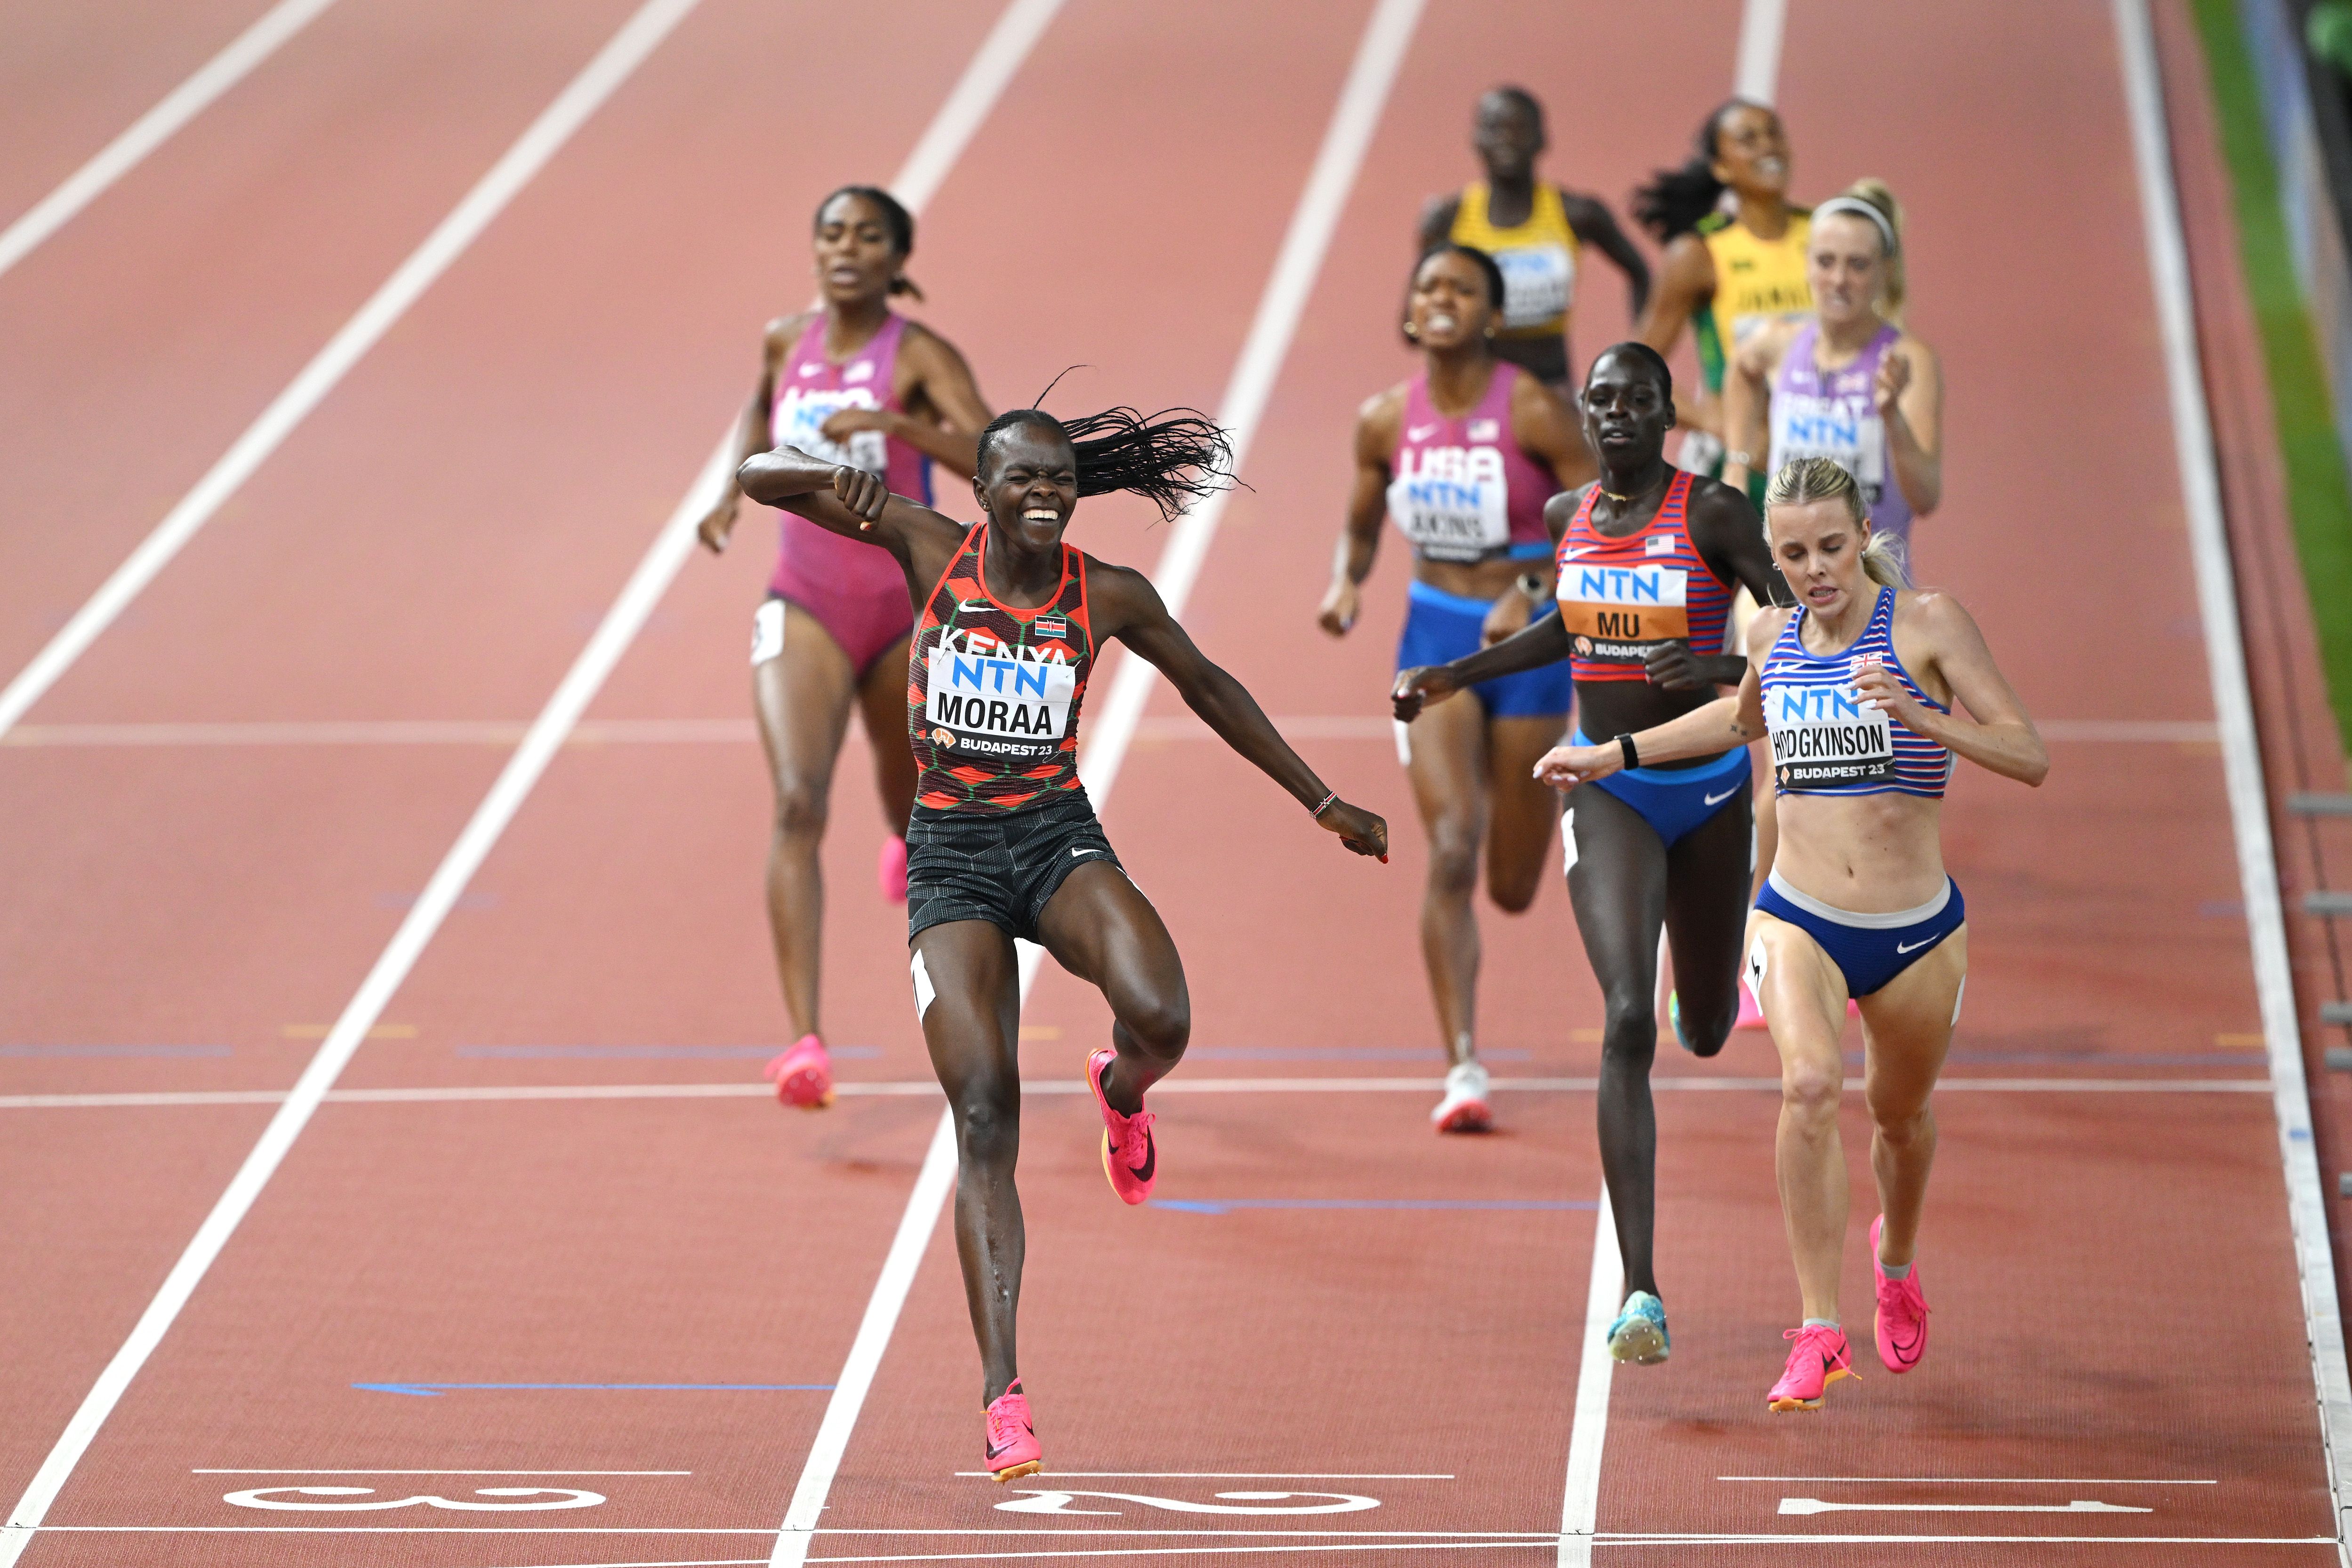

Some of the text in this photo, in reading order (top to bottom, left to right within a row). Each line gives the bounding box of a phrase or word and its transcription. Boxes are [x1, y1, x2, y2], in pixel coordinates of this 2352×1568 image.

[1789, 416, 1857, 442] NTN
[1400, 446, 1505, 484] USA
[1409, 482, 1480, 509] NTN
[1581, 568, 1659, 603] NTN
[1597, 611, 1640, 638] MU
[1595, 643, 1653, 658] BUDAPE
[952, 655, 1048, 699] NTN
[937, 692, 1052, 736] MORAA
[1782, 688, 1859, 722] NTN
[960, 737, 1052, 756] BUDAPEST 23
[1772, 724, 1885, 761] HODGKINSON
[1793, 764, 1886, 780] BUDAPEST 23
[223, 1487, 606, 1511] 3
[994, 1490, 1381, 1515] 2
[1777, 1498, 2154, 1515] 1
